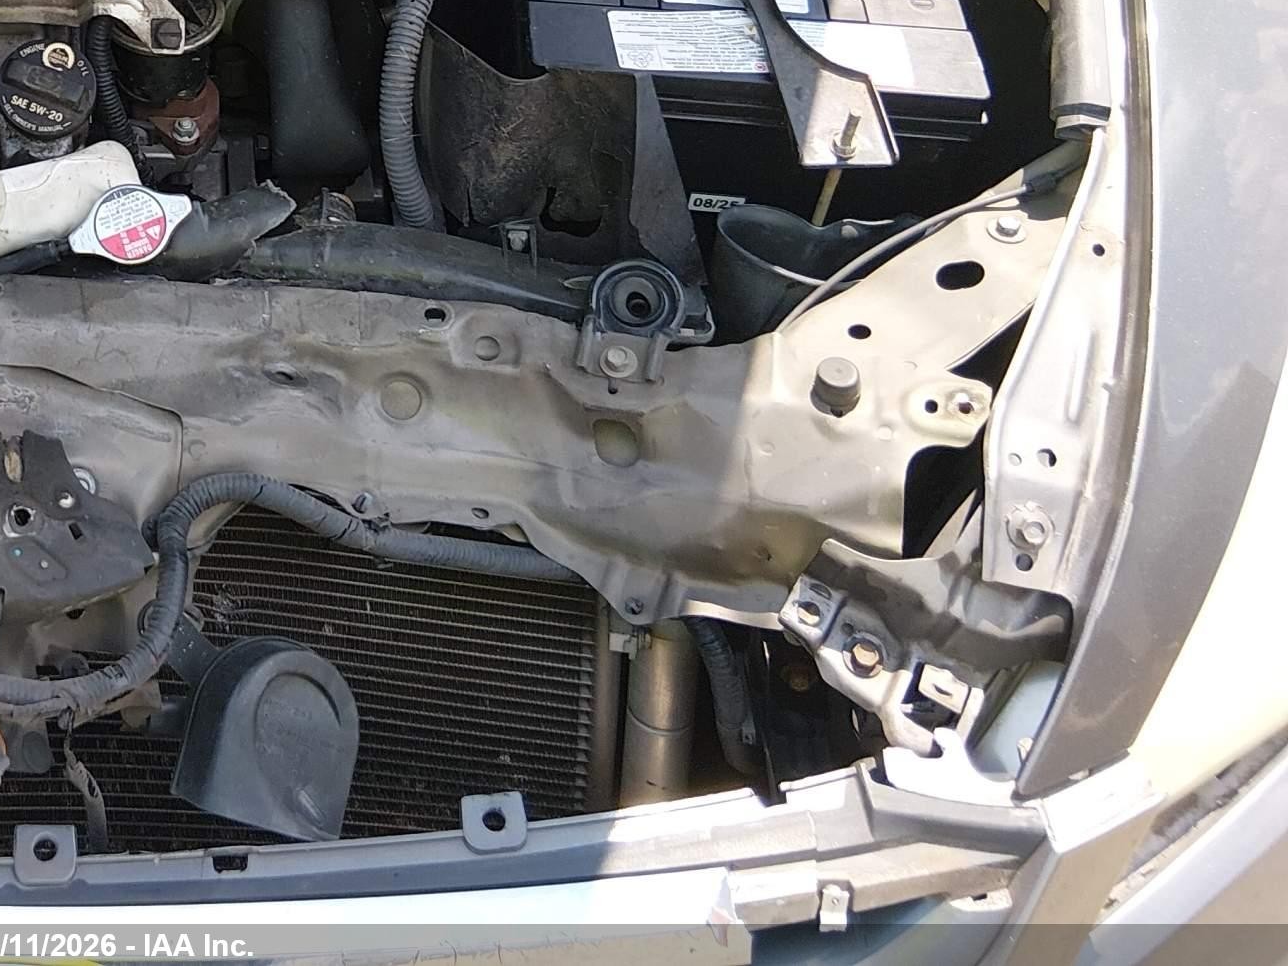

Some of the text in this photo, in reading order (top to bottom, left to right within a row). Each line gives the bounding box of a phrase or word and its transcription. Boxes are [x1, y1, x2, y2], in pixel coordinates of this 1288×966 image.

[19, 43, 46, 58] ENGINE
[76, 59, 89, 77] OIL
[10, 95, 64, 122] SAE 5W-20
